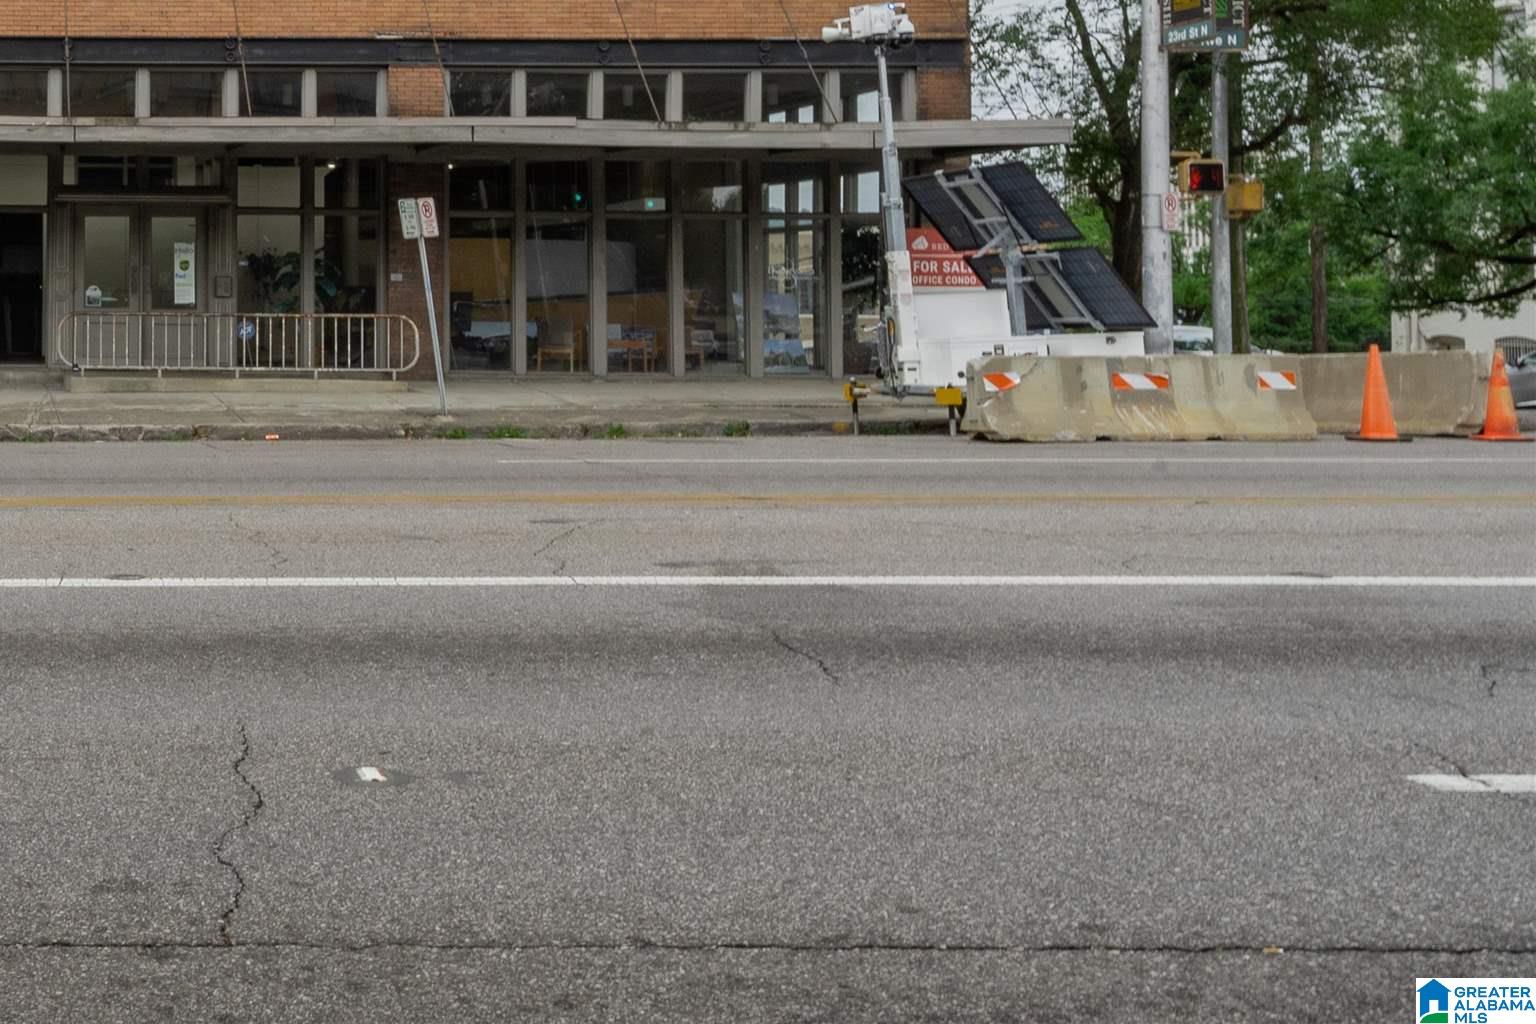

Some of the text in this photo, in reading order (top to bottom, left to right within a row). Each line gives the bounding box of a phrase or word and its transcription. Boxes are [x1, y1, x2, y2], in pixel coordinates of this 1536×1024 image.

[1167, 23, 1208, 44] 23rd St N
[1227, 34, 1237, 46] N
[913, 261, 938, 273] FOR
[912, 275, 977, 286] OFFICE CONDO
